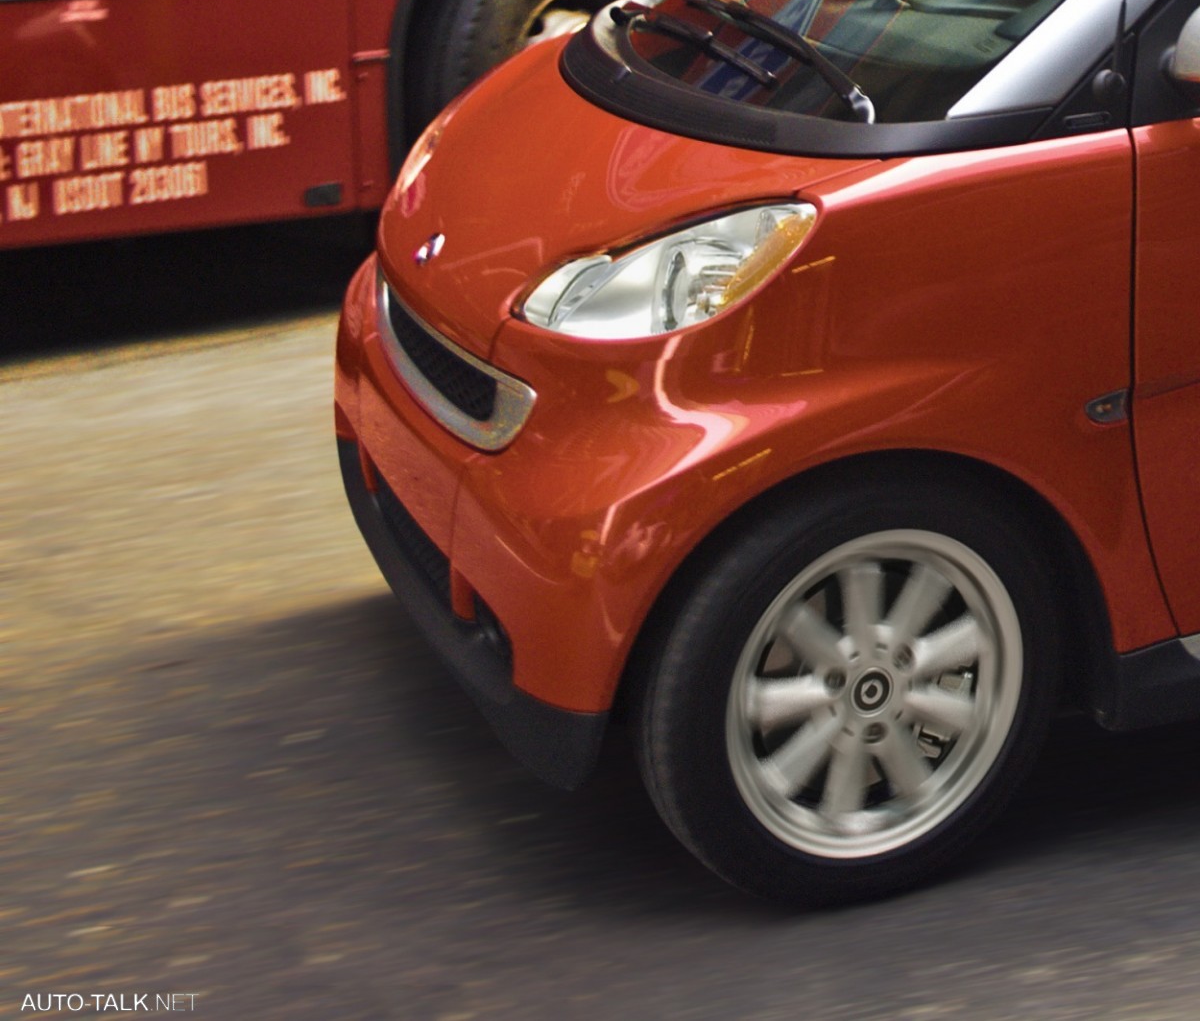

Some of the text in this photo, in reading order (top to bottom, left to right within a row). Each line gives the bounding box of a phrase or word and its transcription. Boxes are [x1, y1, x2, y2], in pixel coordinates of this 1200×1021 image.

[152, 83, 196, 121] BUS
[200, 72, 302, 117] SERVICES,
[304, 68, 347, 105] INC.
[16, 136, 75, 179] GRAY
[81, 130, 130, 171] LINE
[133, 125, 163, 163] NY
[167, 117, 244, 160] TOURS,
[246, 112, 291, 150] INC.
[7, 181, 39, 221] NJ
[53, 171, 124, 215] USDOT
